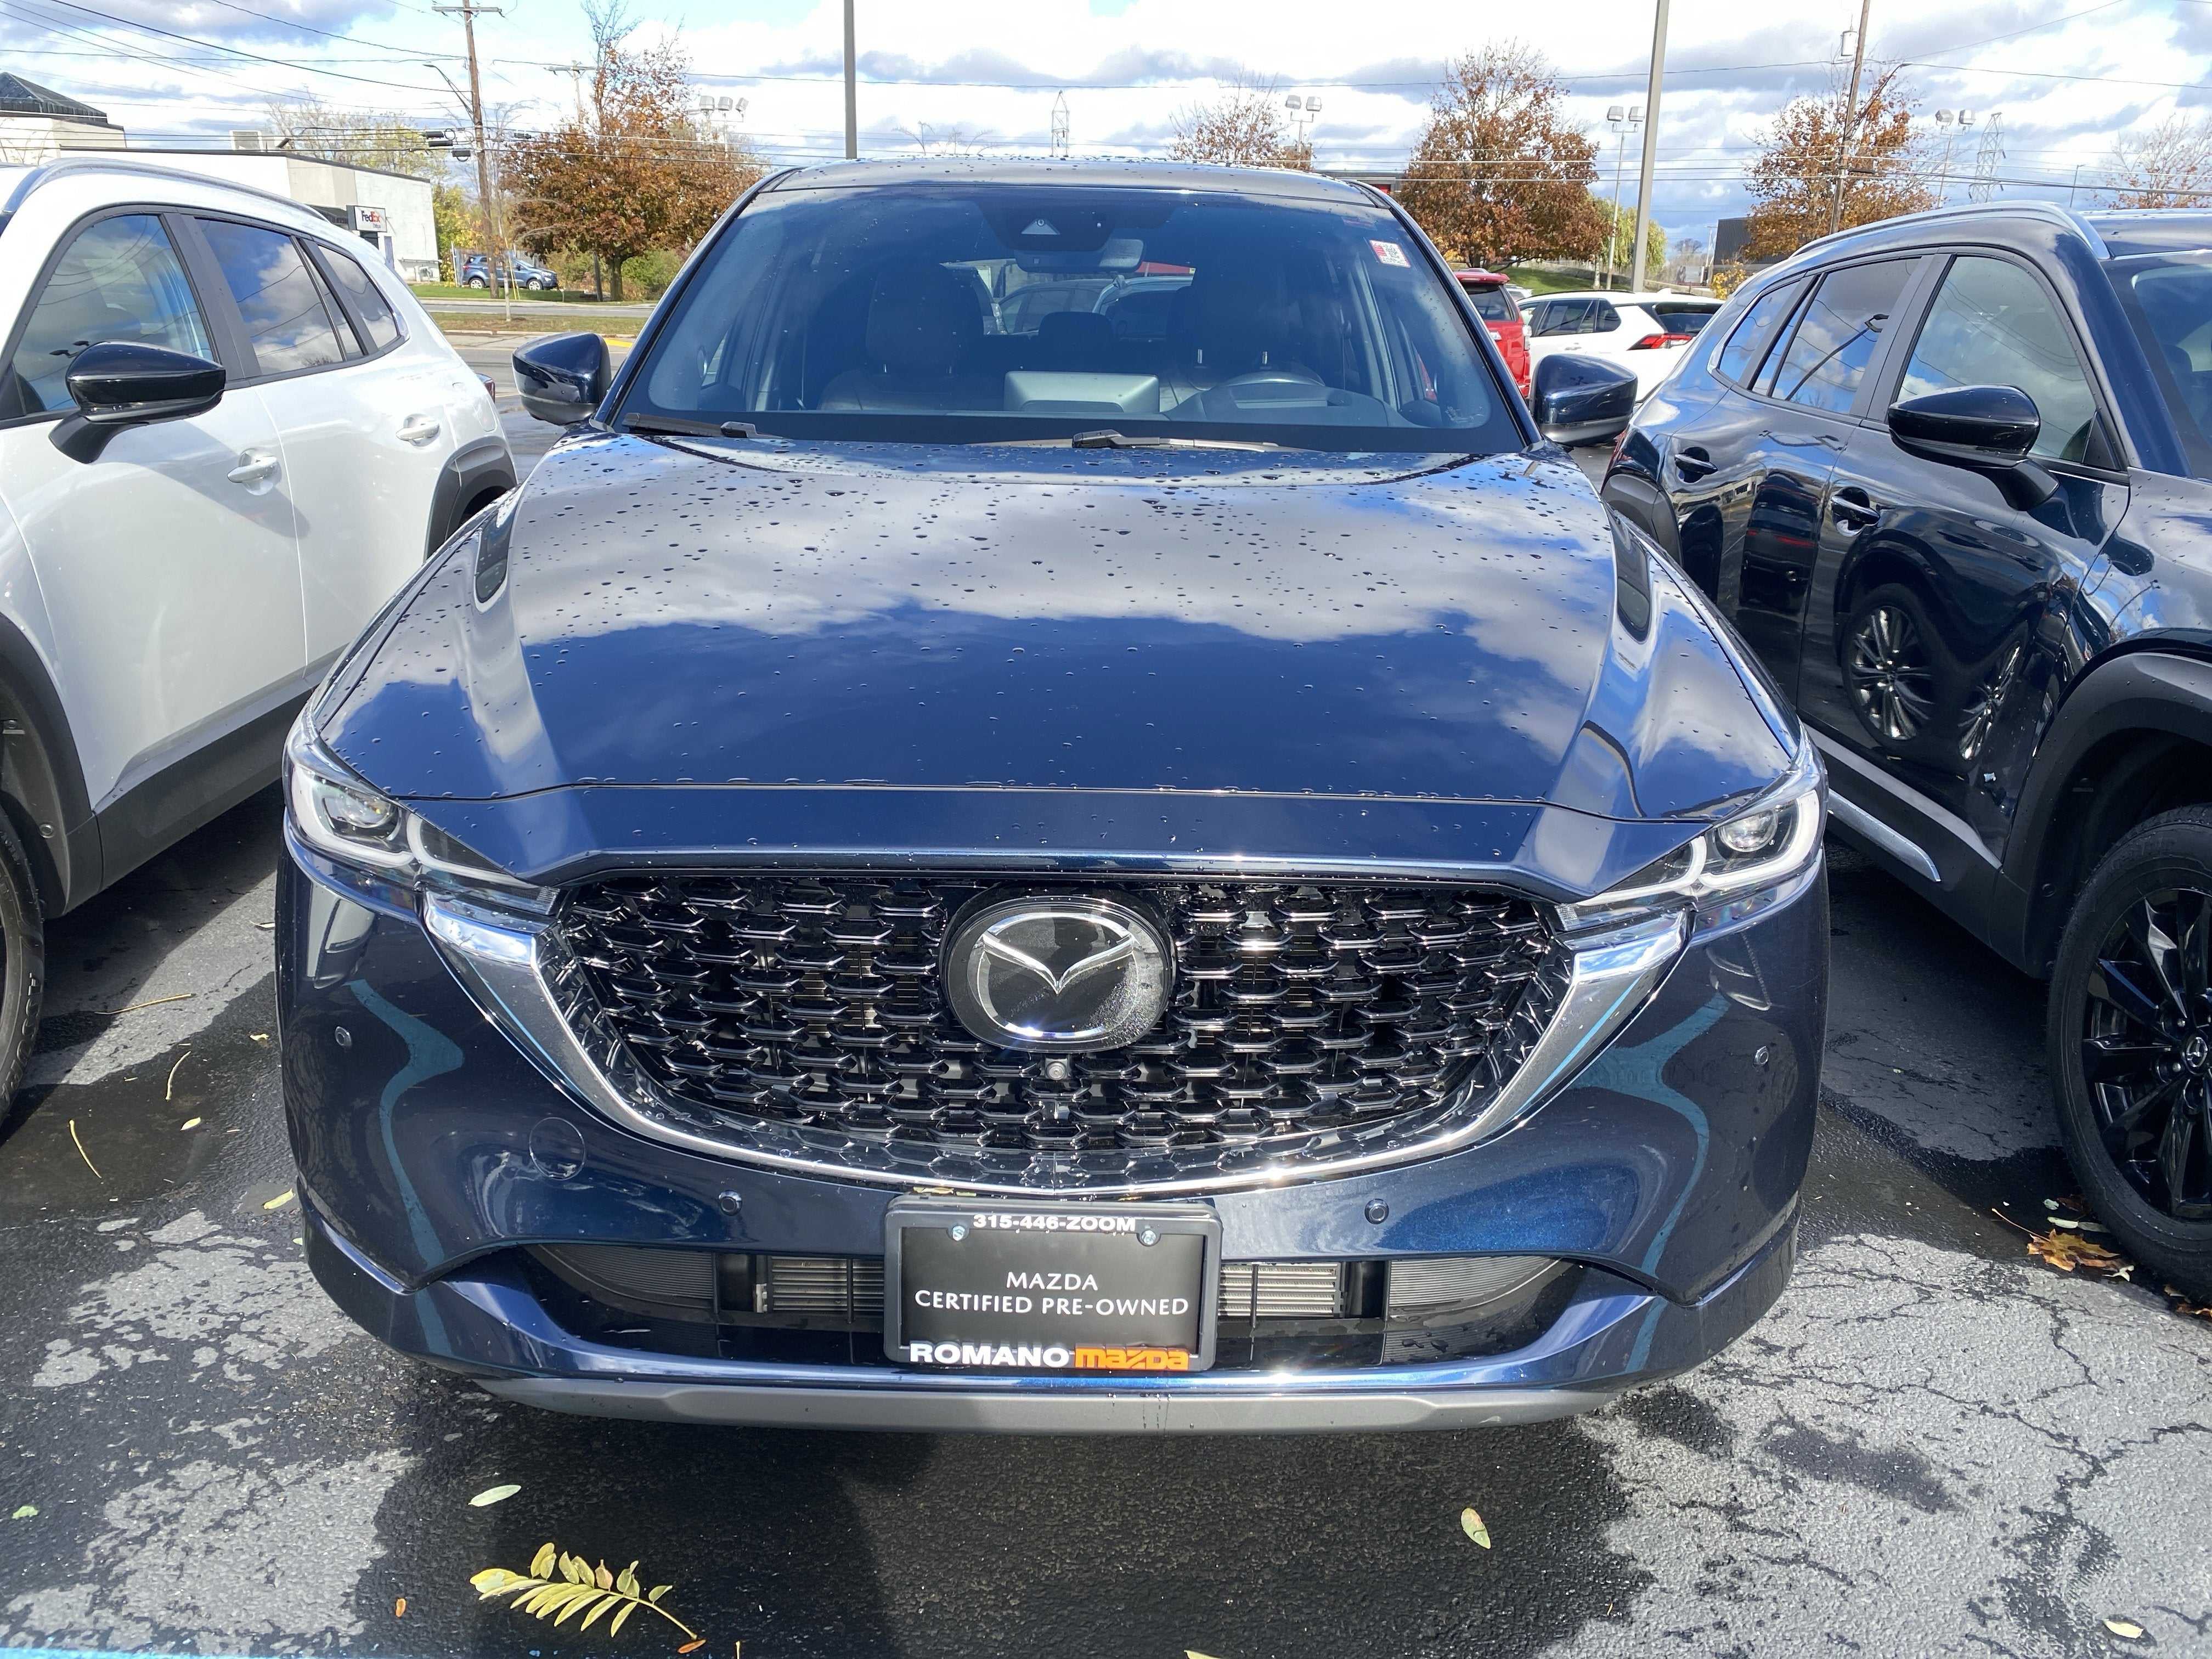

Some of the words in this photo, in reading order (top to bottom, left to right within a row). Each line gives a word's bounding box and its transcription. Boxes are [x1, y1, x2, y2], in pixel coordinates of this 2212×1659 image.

[361, 210, 380, 222] FedEx
[973, 1214, 1136, 1232] 315-446-ZOOM
[1006, 1272, 1098, 1291] MAZDA
[915, 1290, 1032, 1313] CERTIFIED
[1042, 1297, 1189, 1316] PRE-OWNED
[910, 1342, 1069, 1368] ROMANO
